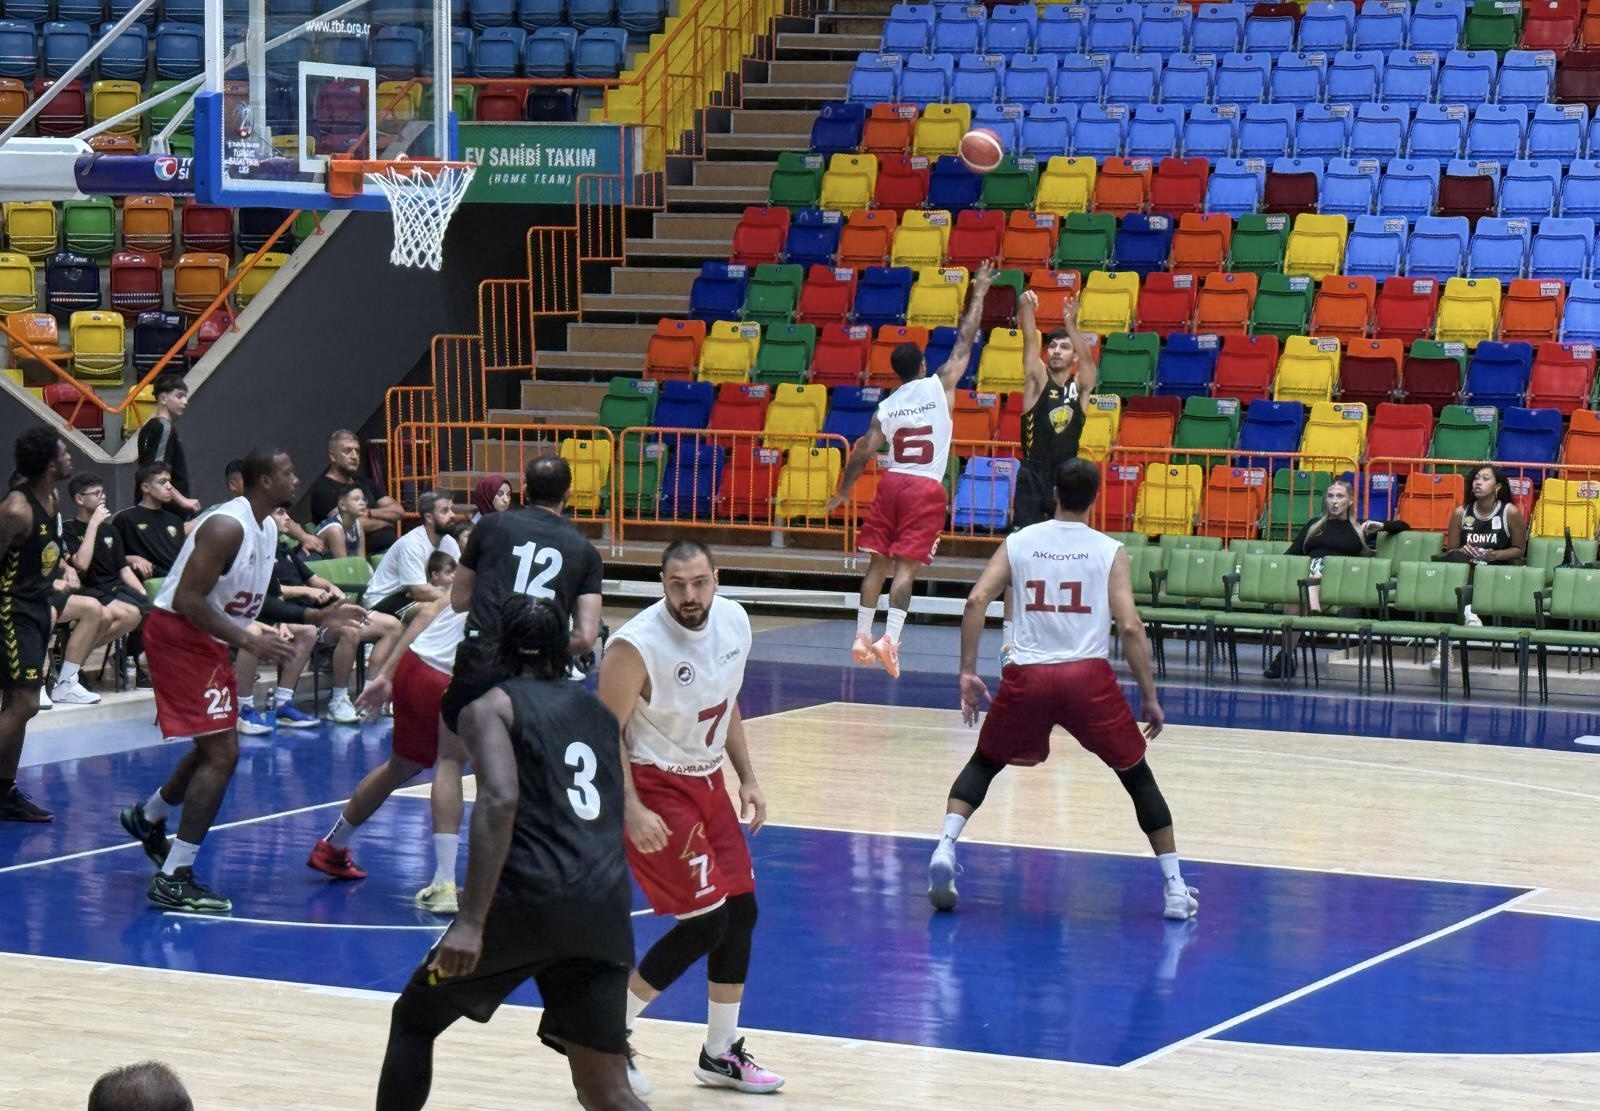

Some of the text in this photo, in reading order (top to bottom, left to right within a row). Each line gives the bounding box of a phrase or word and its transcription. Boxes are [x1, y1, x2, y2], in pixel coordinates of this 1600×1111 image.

[305, 19, 371, 38] www.tbf.org.tr
[465, 143, 596, 167] EV SAHİBİ TAKIM
[887, 401, 937, 418] WATKINS
[892, 424, 935, 465] 6
[1032, 551, 1090, 561] AKKOYUN
[1466, 534, 1498, 545] KONYA
[511, 540, 564, 601] 12
[1024, 579, 1092, 614] 11
[697, 697, 729, 749] 7
[564, 741, 602, 821] 3
[688, 854, 709, 889] 7
